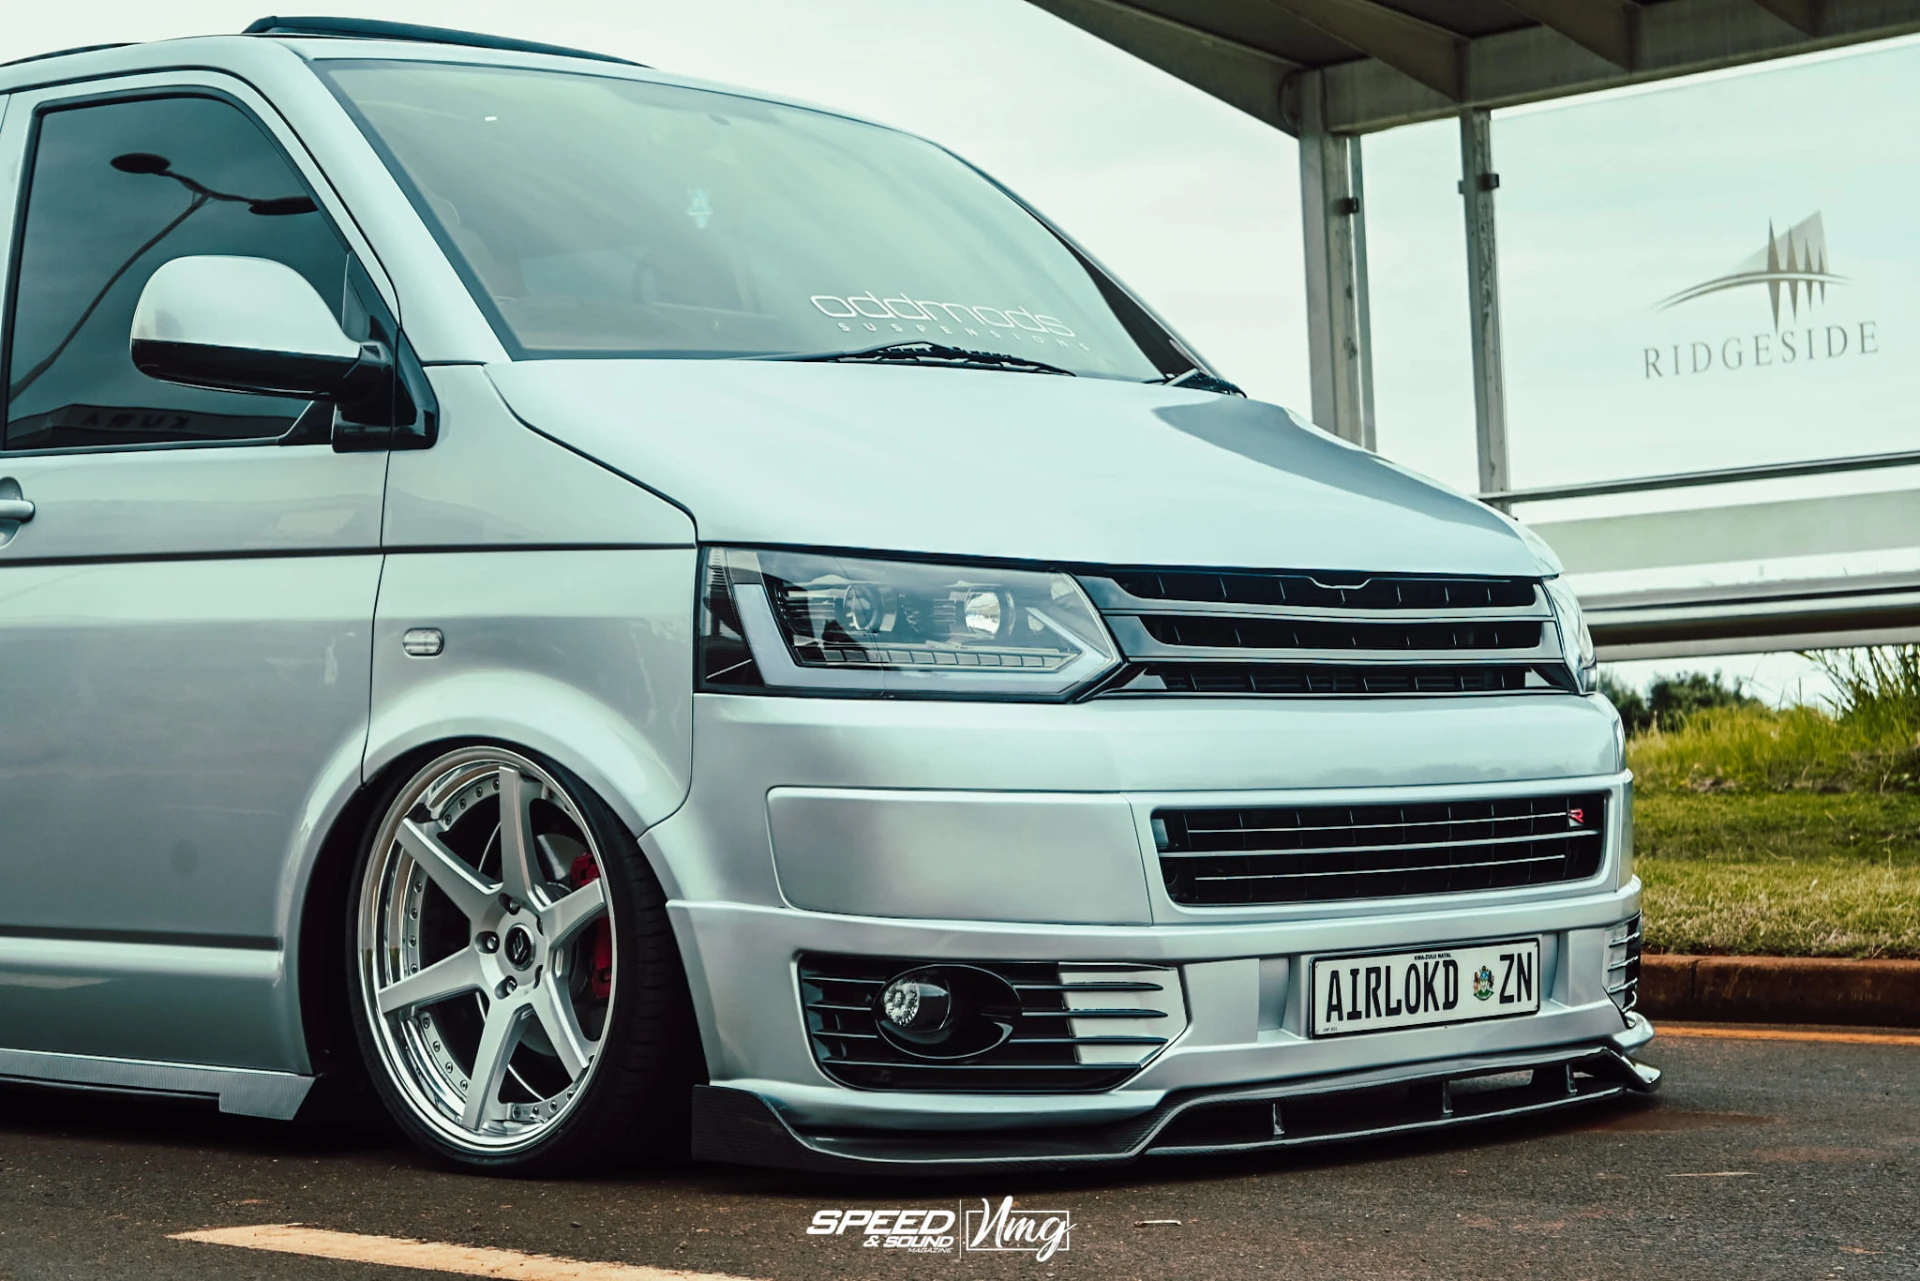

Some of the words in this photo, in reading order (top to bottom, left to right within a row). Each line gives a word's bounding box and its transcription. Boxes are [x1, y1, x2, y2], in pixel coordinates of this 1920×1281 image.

[810, 290, 1075, 337] oddmods
[1643, 320, 1879, 379] RIDGESIDE
[1326, 959, 1459, 1023] AIRLOKD
[1499, 951, 1532, 1004] ZN
